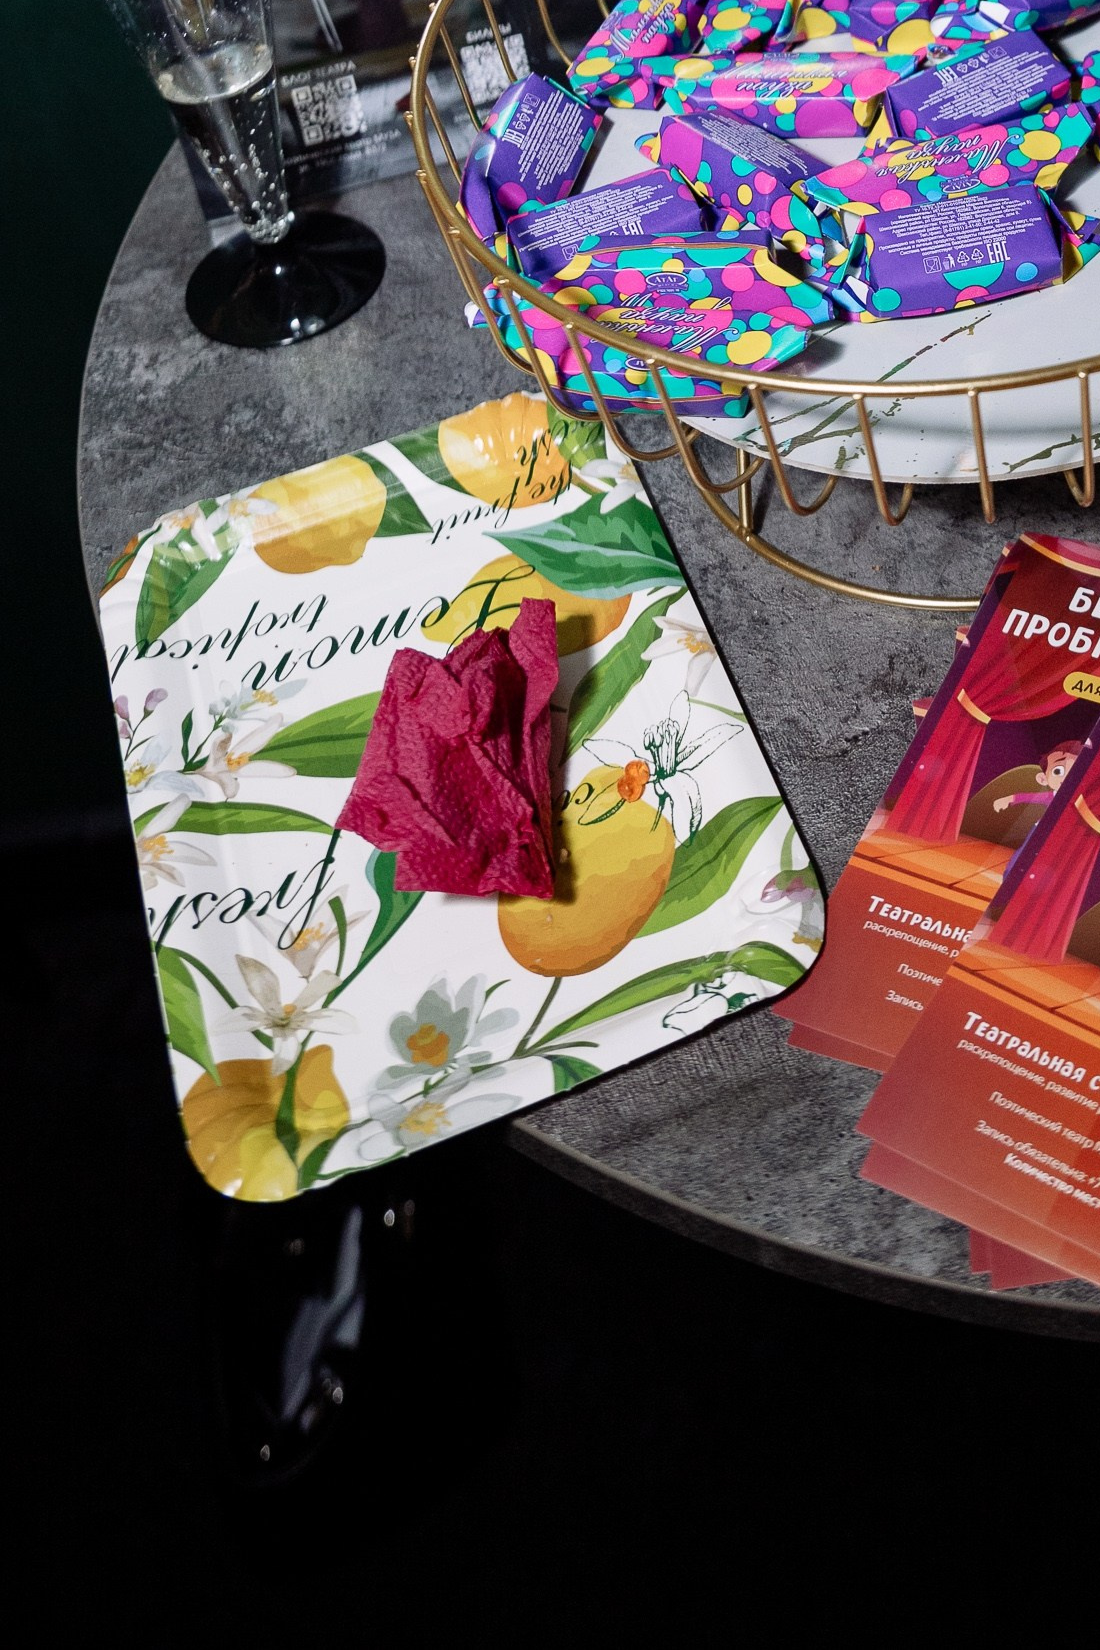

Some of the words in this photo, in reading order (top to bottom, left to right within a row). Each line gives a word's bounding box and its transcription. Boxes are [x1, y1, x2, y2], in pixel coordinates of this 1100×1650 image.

[877, 135, 1021, 183] Маленькая
[906, 134, 981, 161] пауза
[424, 480, 516, 545] fruit
[107, 591, 328, 684] tropical
[237, 562, 536, 691] Lemon
[146, 824, 339, 952] fresh
[863, 920, 949, 956] раскрепощение,
[868, 895, 973, 943] Театральна
[885, 990, 924, 1011] Запись
[963, 1011, 1087, 1083] Театральная
[988, 1090, 1063, 1133] Поэтический
[1061, 1127, 1095, 1149] театр
